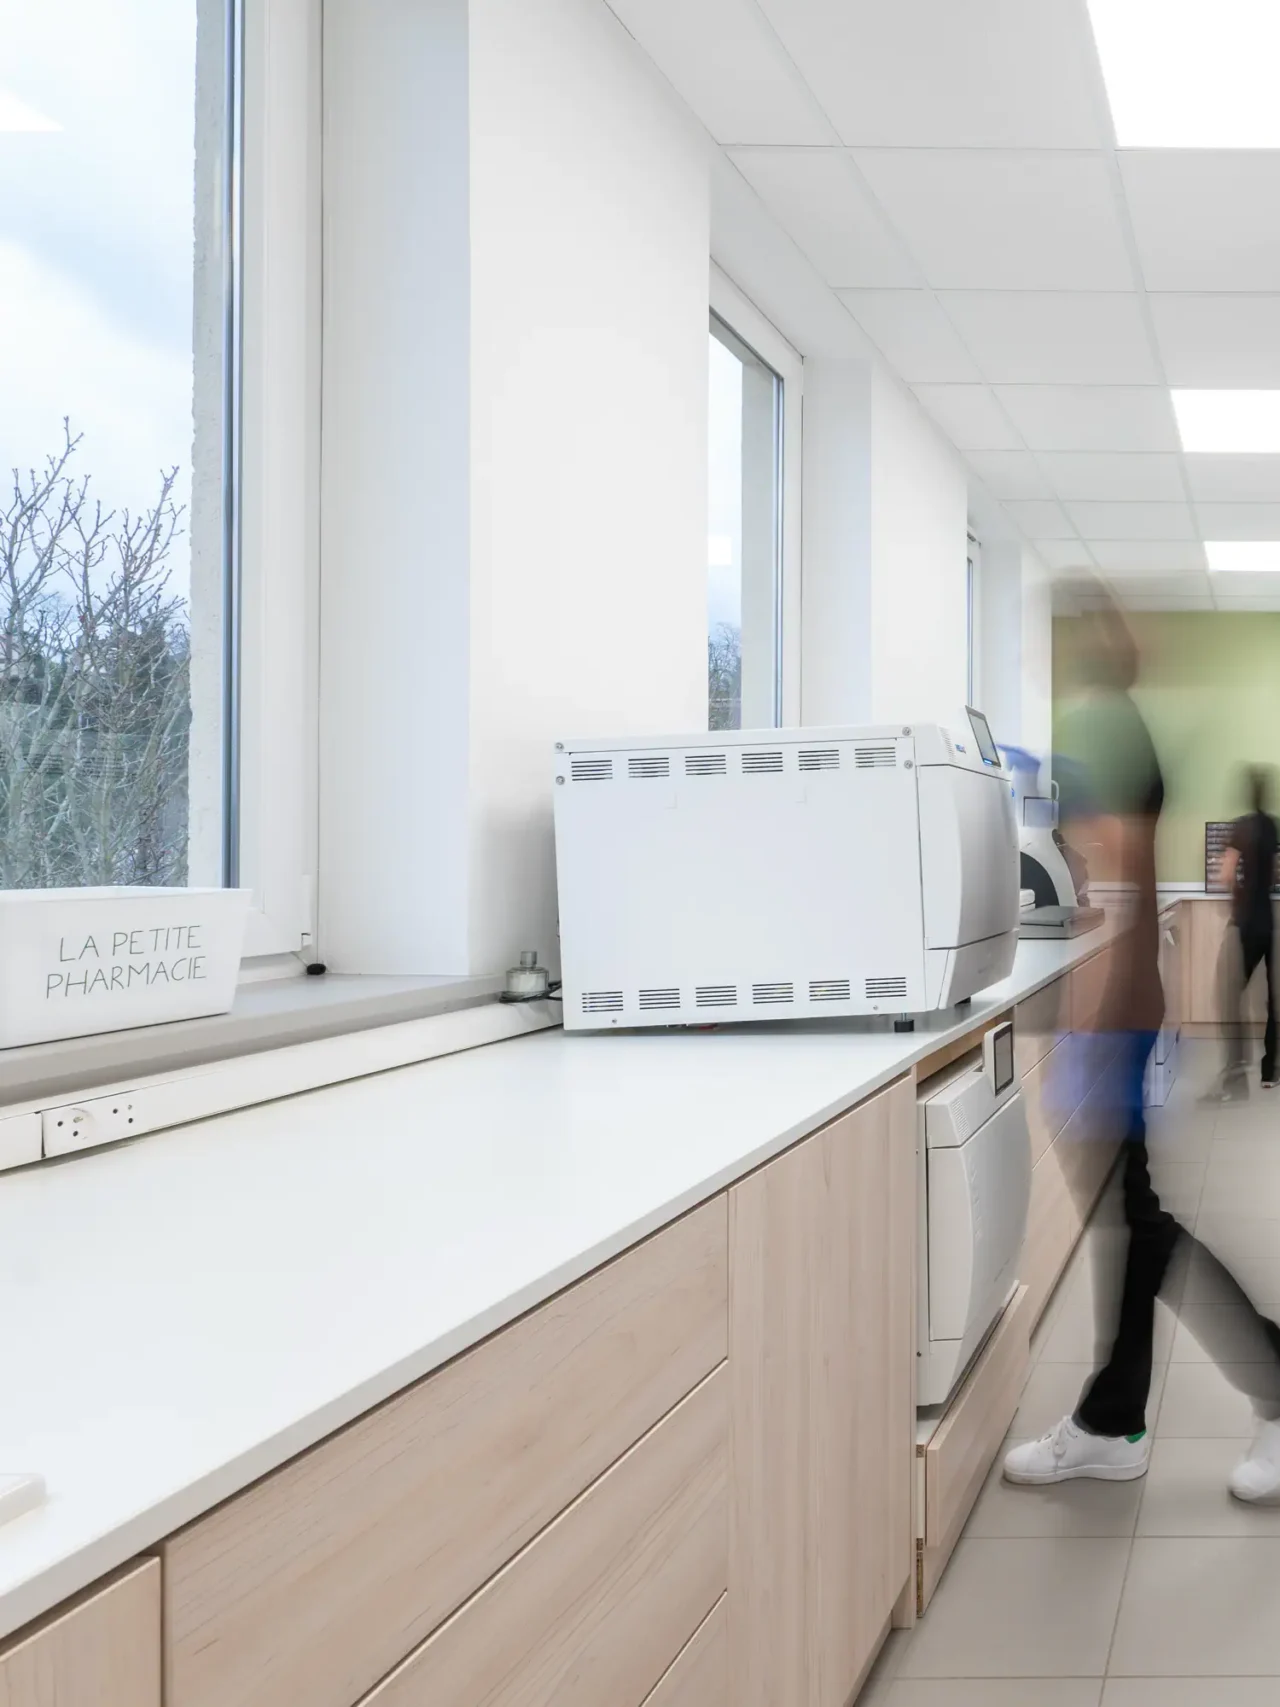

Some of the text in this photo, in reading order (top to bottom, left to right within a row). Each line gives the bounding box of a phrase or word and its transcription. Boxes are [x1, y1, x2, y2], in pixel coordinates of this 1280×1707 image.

[59, 924, 201, 962] LA PETITE
[46, 955, 207, 999] PHARMACIE
